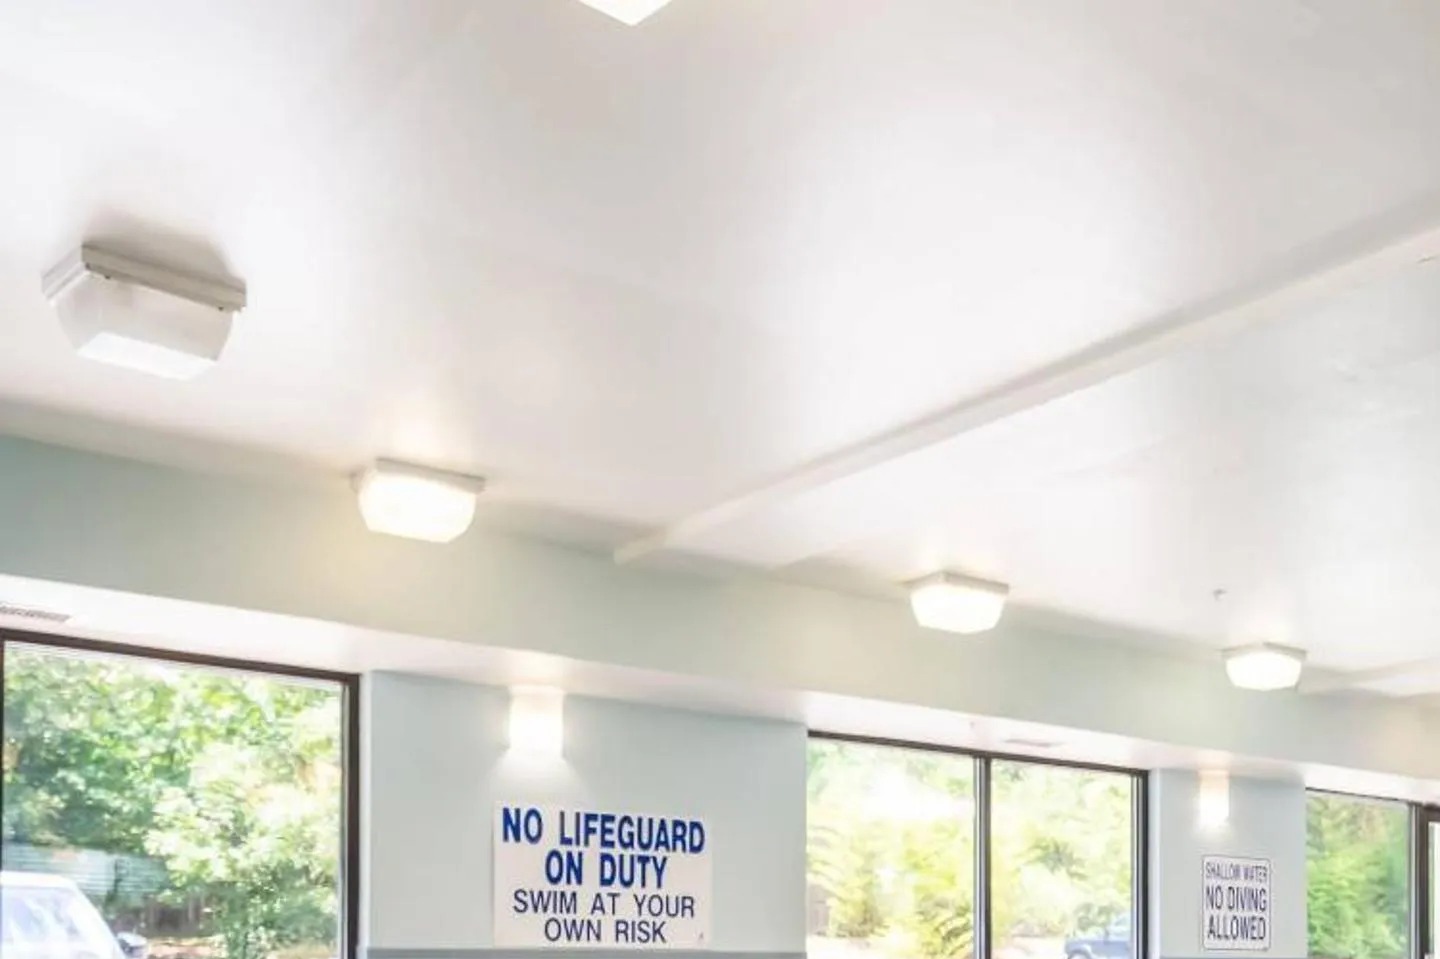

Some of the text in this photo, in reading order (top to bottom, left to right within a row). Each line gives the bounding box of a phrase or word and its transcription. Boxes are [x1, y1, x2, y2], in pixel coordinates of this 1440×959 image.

[502, 807, 706, 854] NO LIFEGUARD
[545, 850, 668, 889] ON DUTY
[513, 889, 695, 918] SWIM AT YOUR
[1206, 885, 1266, 912] NO DIVING
[544, 917, 667, 943] OWN RISK
[1207, 915, 1266, 940] ALLOWED
